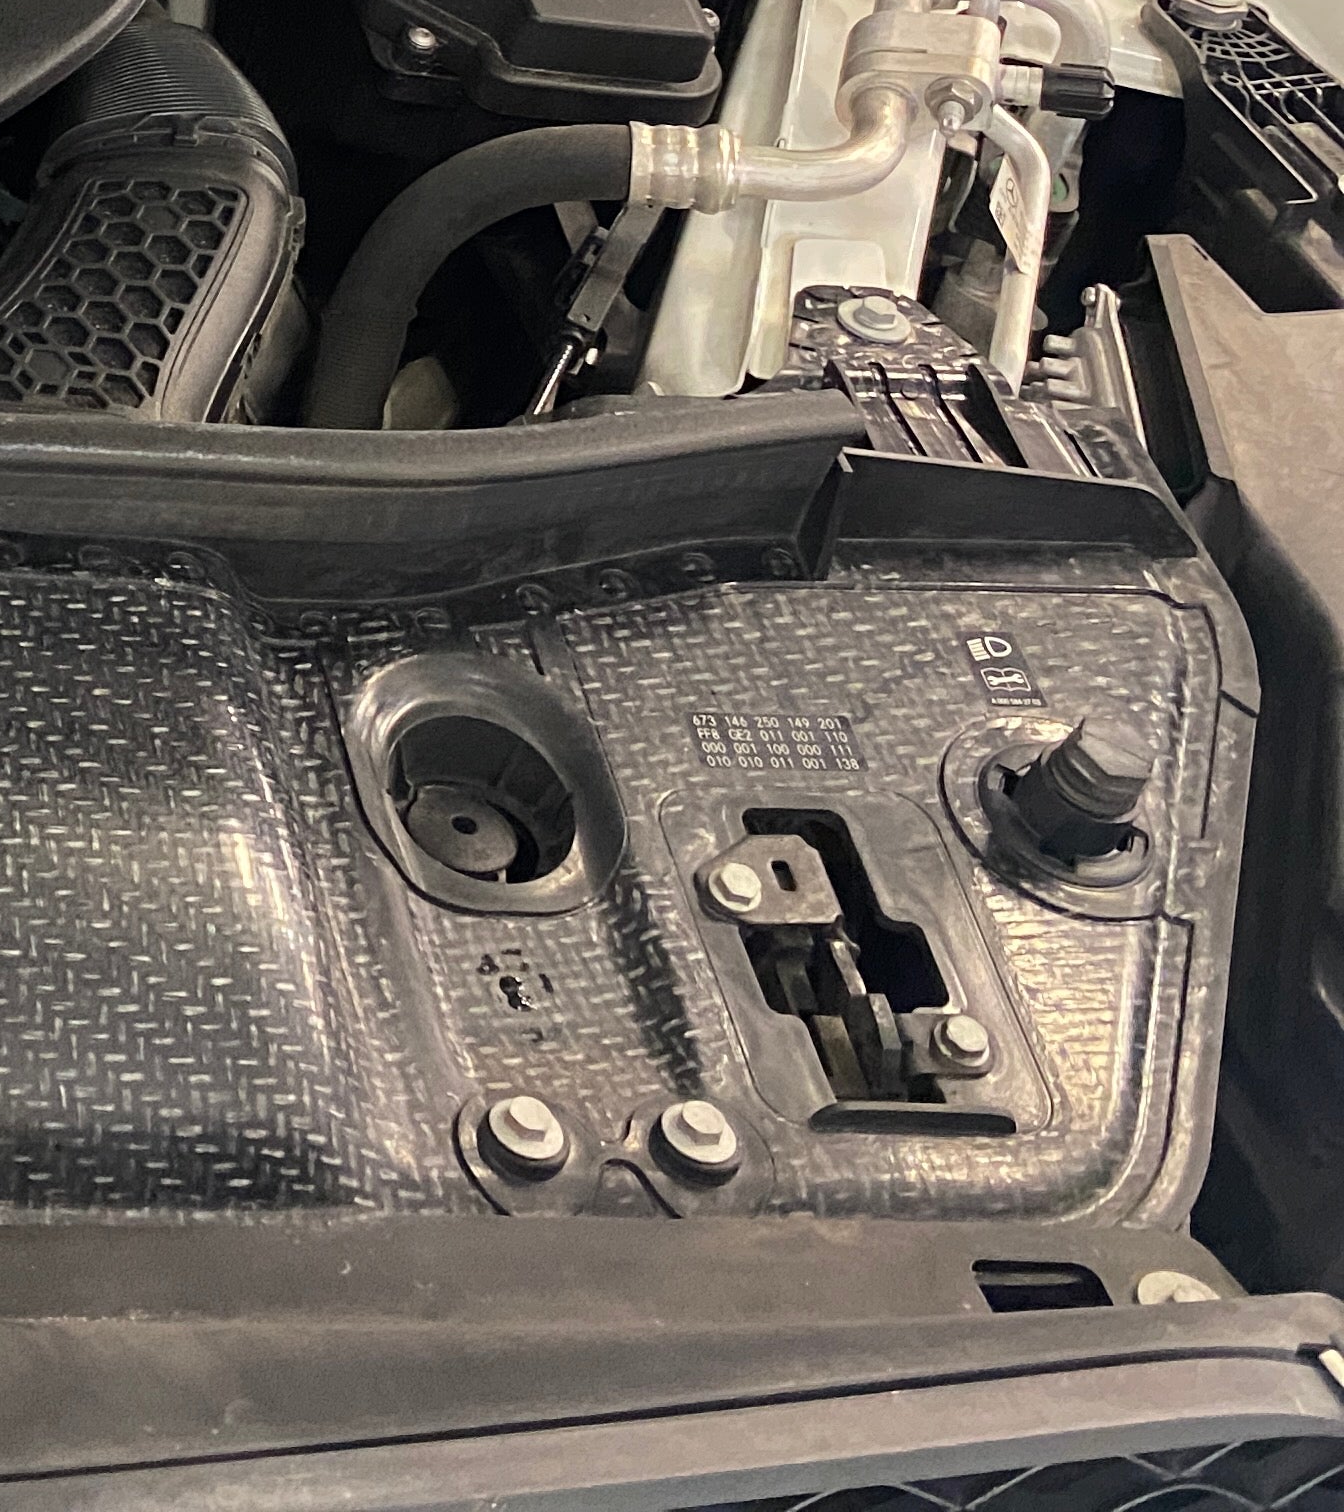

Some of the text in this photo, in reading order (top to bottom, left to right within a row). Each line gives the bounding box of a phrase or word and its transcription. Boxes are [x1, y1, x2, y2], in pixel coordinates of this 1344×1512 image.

[693, 715, 841, 729] 673 146 250 149 201
[760, 730, 783, 741] 011
[792, 731, 814, 742] 001
[825, 731, 847, 742] 110
[702, 742, 852, 756] 000 001 100 000 111
[707, 756, 859, 770] 010 010 011 001 138
